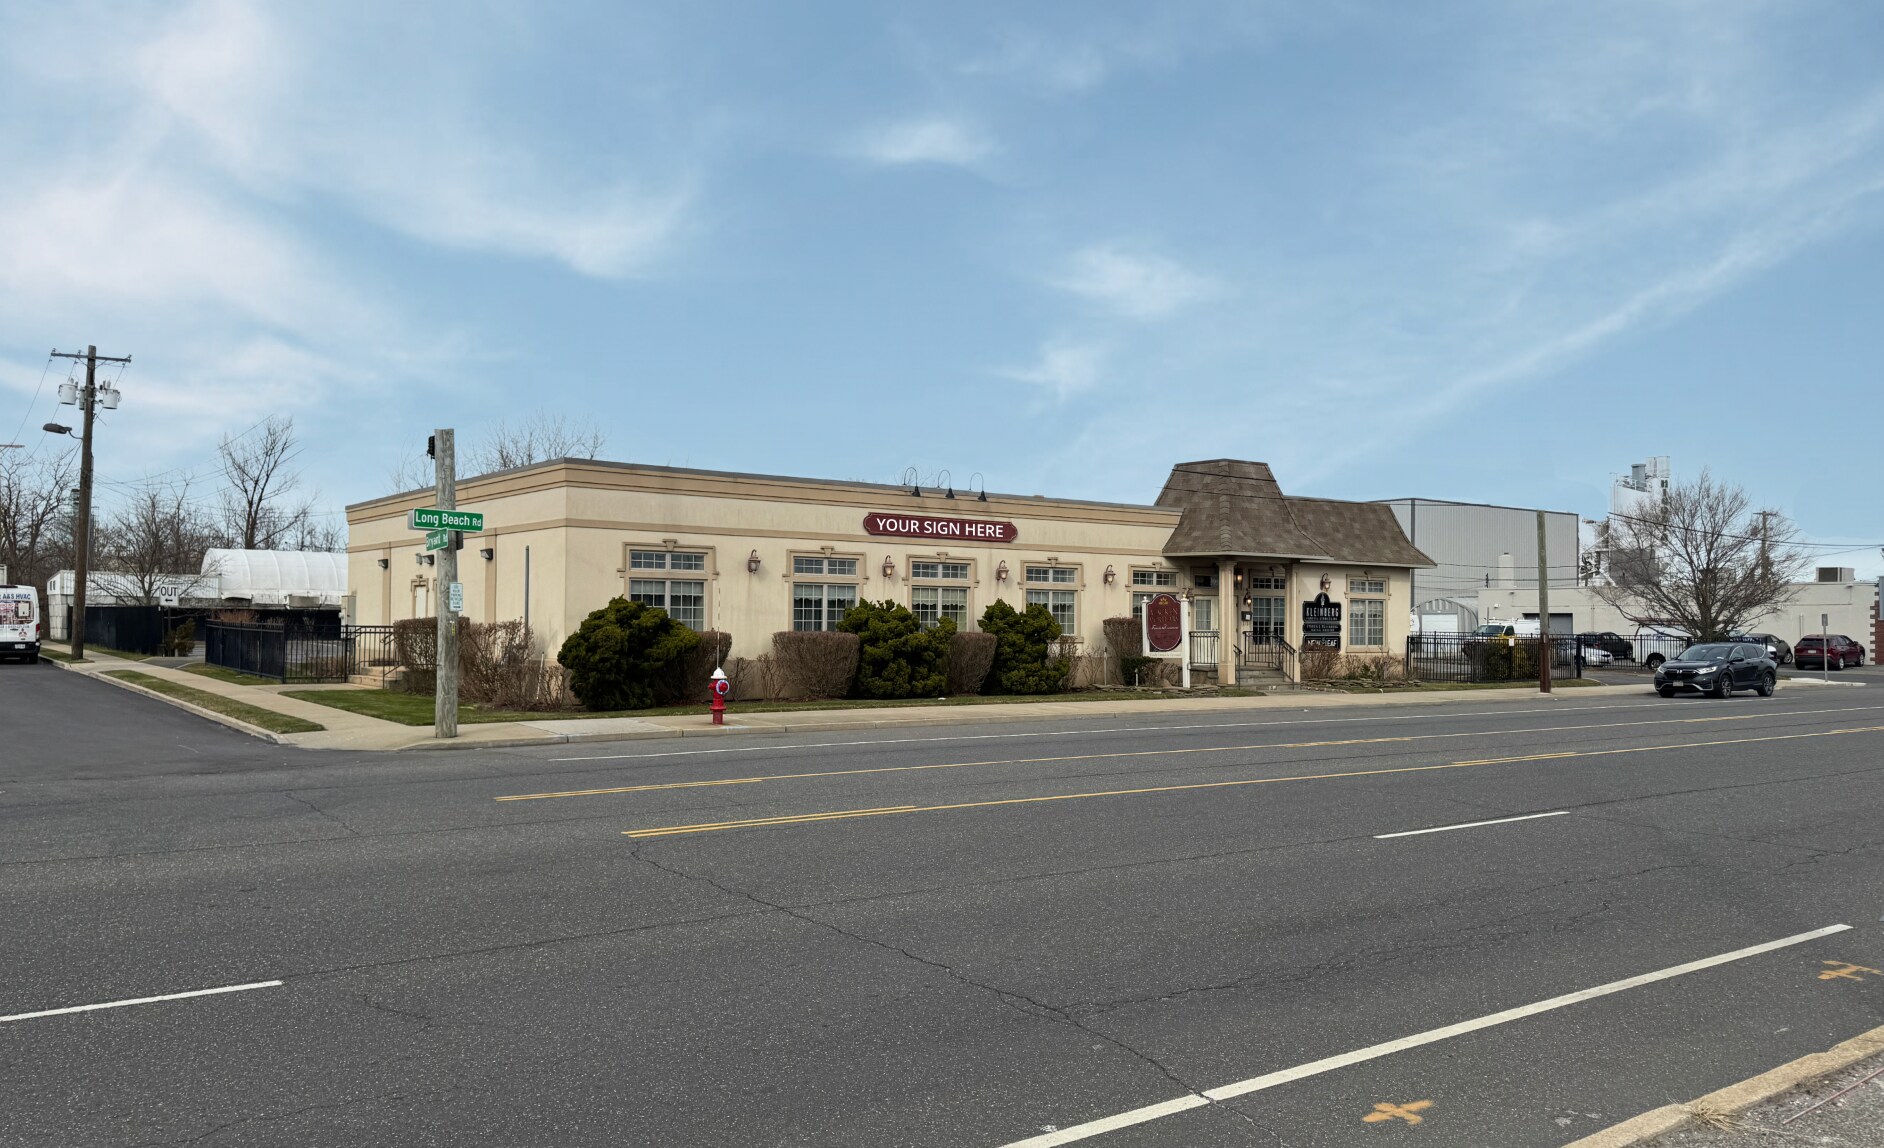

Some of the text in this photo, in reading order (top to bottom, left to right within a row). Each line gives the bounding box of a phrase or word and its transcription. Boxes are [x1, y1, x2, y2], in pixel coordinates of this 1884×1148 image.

[415, 511, 482, 527] Long Beach Rd
[877, 518, 1004, 538] YOUR SIGN HERE
[426, 533, 441, 548] Bryant
[161, 586, 178, 597] OUT
[1306, 607, 1339, 616] KLEINBERG
